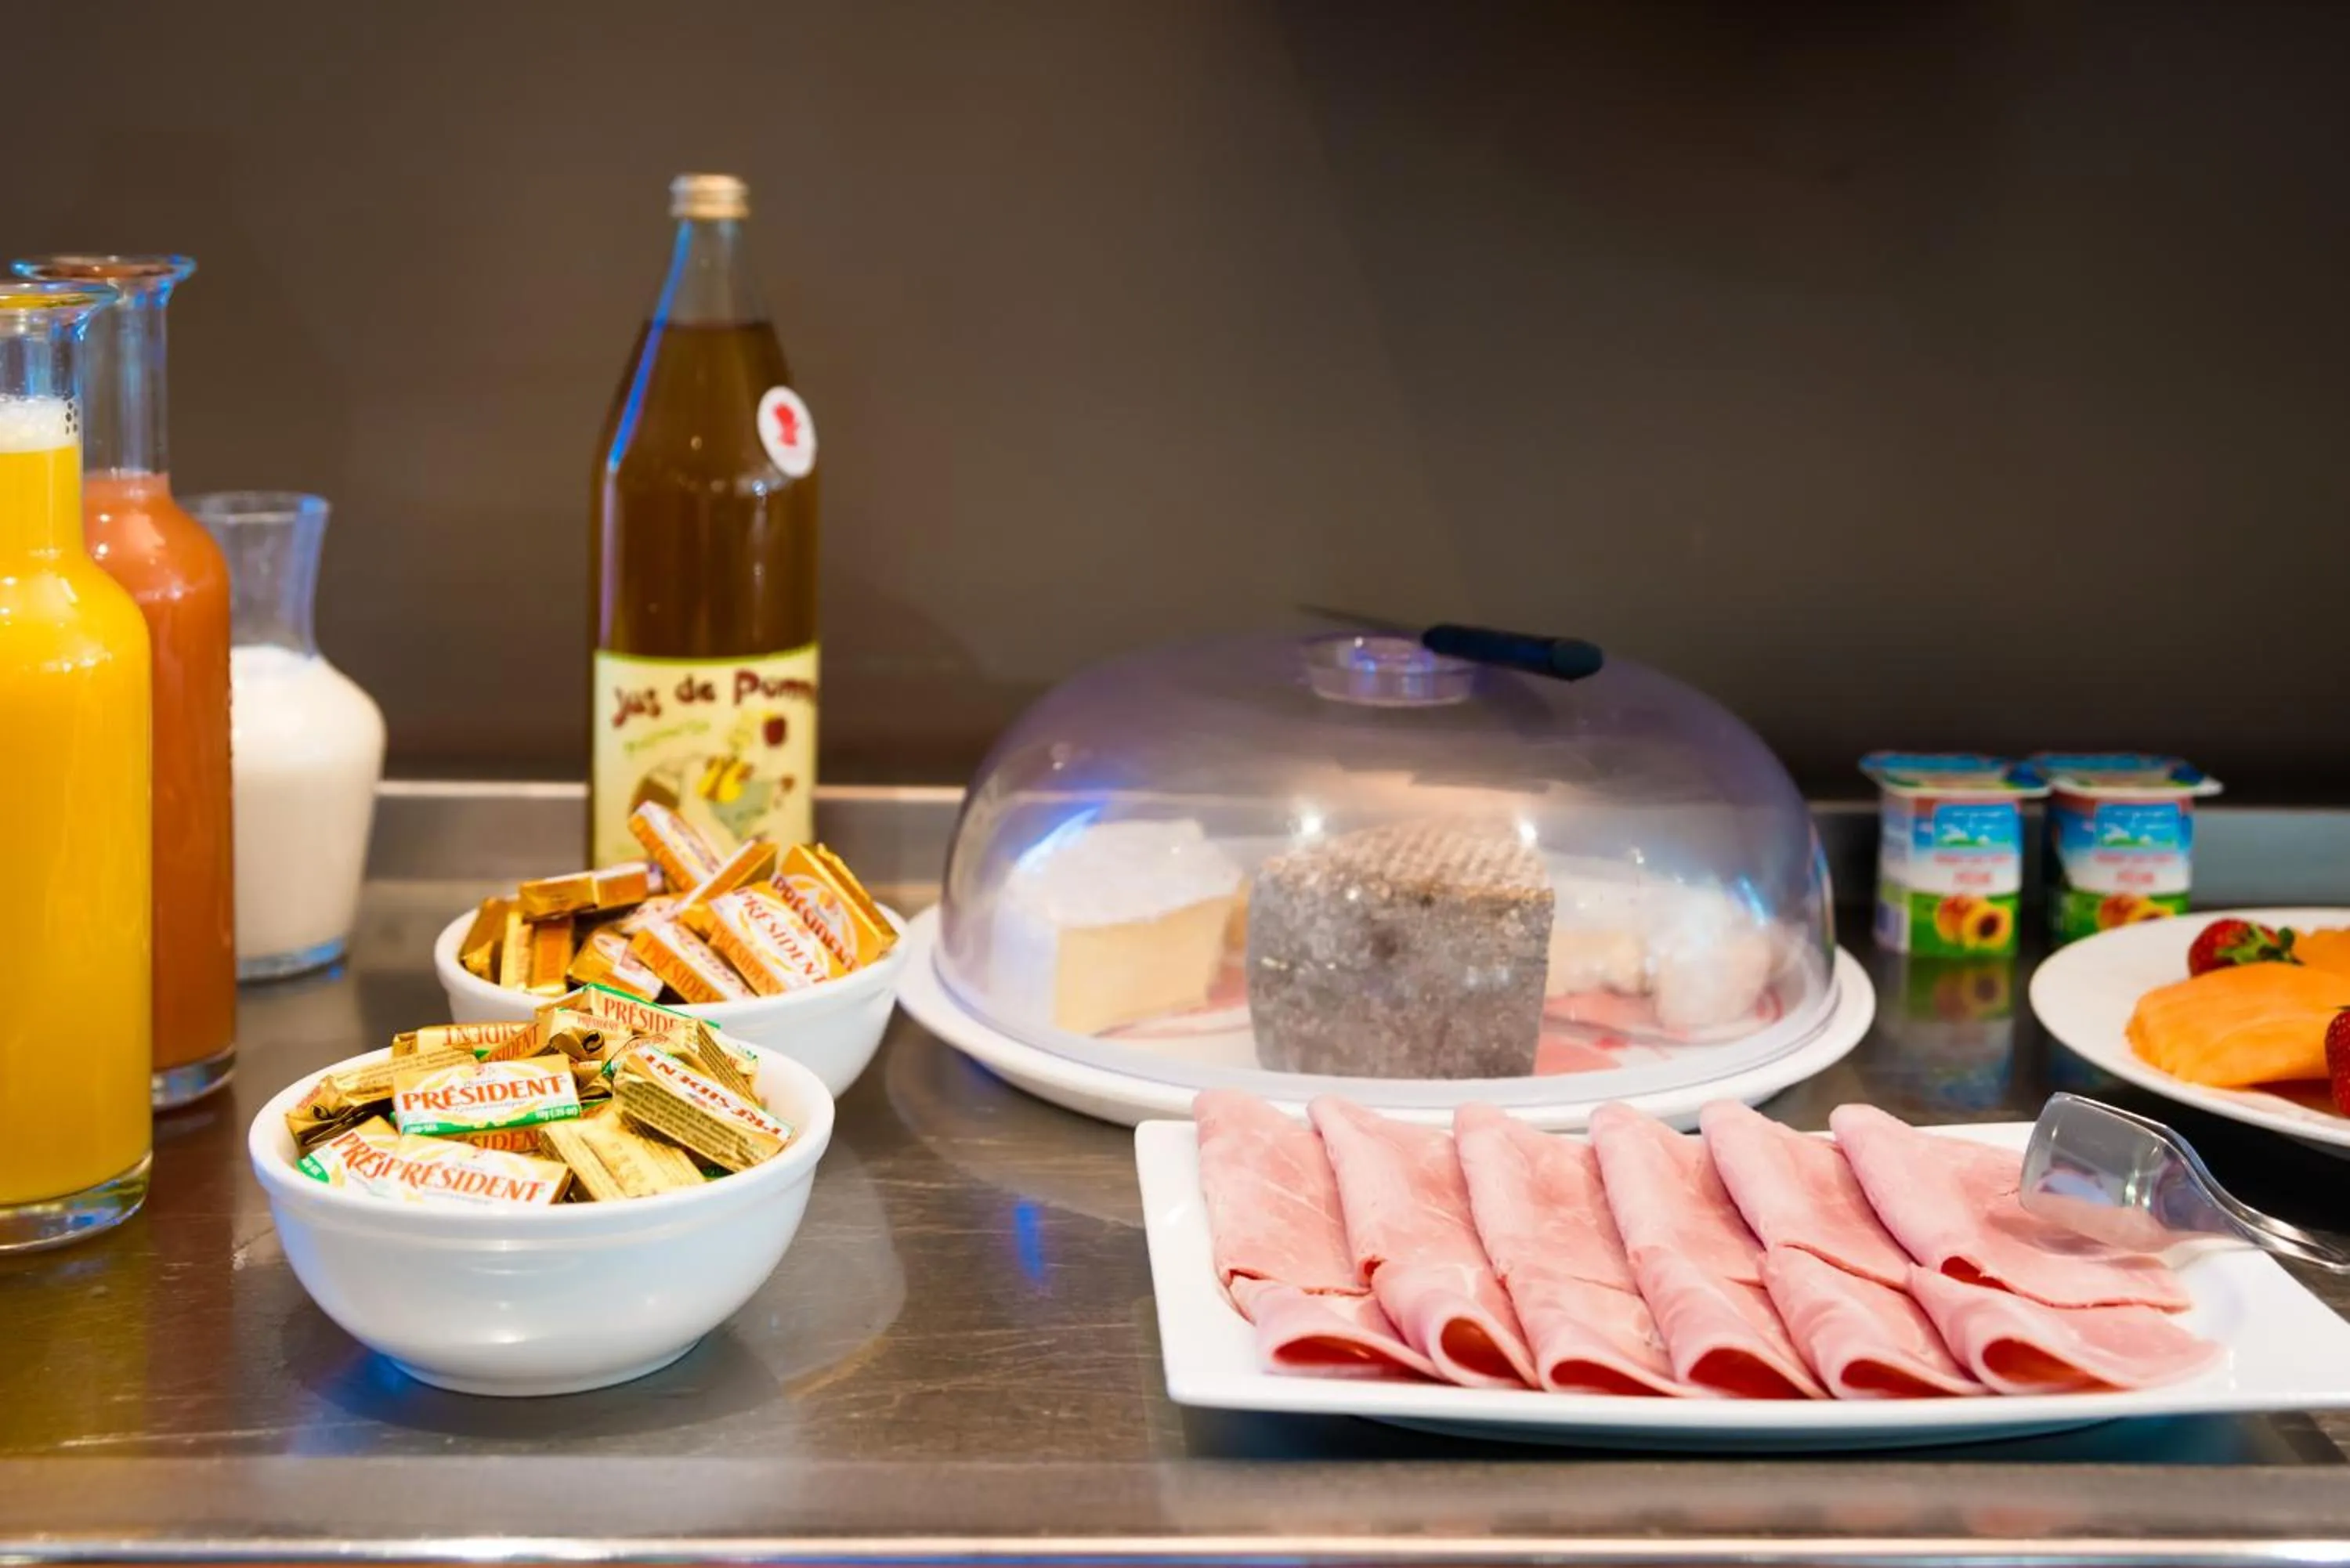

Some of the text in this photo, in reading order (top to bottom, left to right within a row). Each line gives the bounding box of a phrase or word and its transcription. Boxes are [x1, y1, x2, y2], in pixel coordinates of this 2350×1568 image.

[674, 674, 716, 703] de
[732, 888, 827, 984] PRÉSIDENT
[771, 875, 855, 972] PRÉSIDENT
[401, 1075, 563, 1111] PRÉSIDENT
[385, 1155, 546, 1202] PRÉSIDENT
